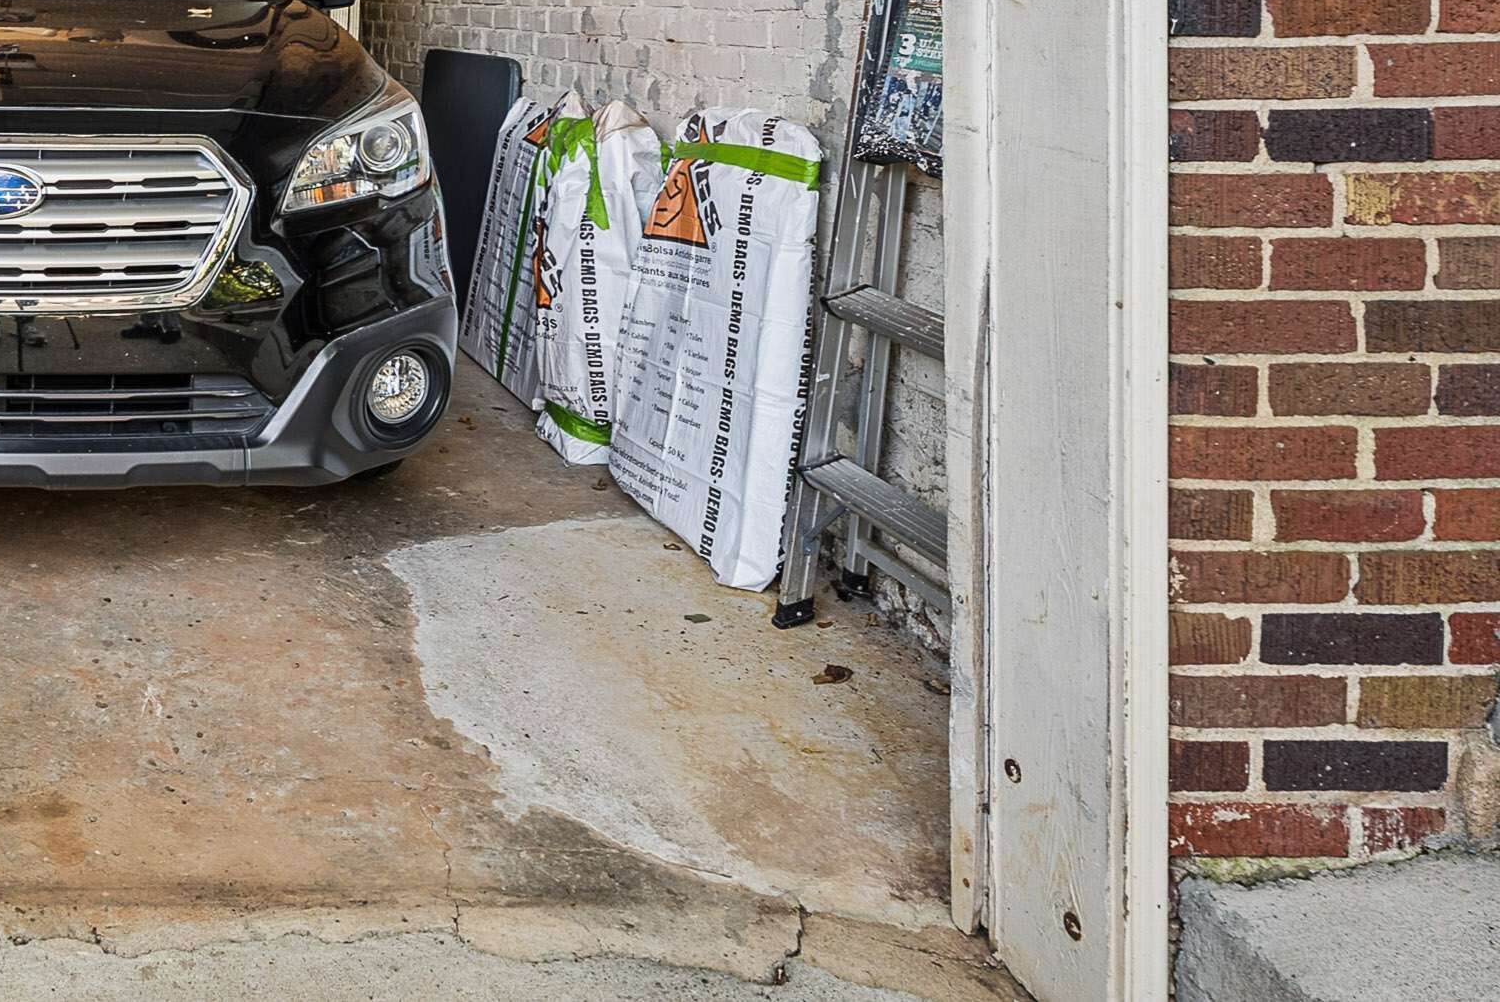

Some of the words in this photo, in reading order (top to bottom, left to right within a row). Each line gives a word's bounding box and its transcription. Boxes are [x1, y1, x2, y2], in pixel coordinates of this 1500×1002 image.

[898, 33, 917, 55] 3
[762, 116, 782, 146] EMO
[736, 193, 754, 236] DEMO
[475, 247, 486, 275] DEMO
[580, 248, 597, 286] DEMO
[732, 239, 749, 281] BAGS
[581, 288, 599, 325] BAGS
[727, 290, 743, 334] DEMO
[585, 332, 603, 368] DEMO
[724, 336, 739, 380] BAGS
[589, 371, 608, 406] BAGS
[717, 387, 733, 433] DEMO
[710, 434, 729, 479] BAGS
[703, 486, 721, 533] DEMO
